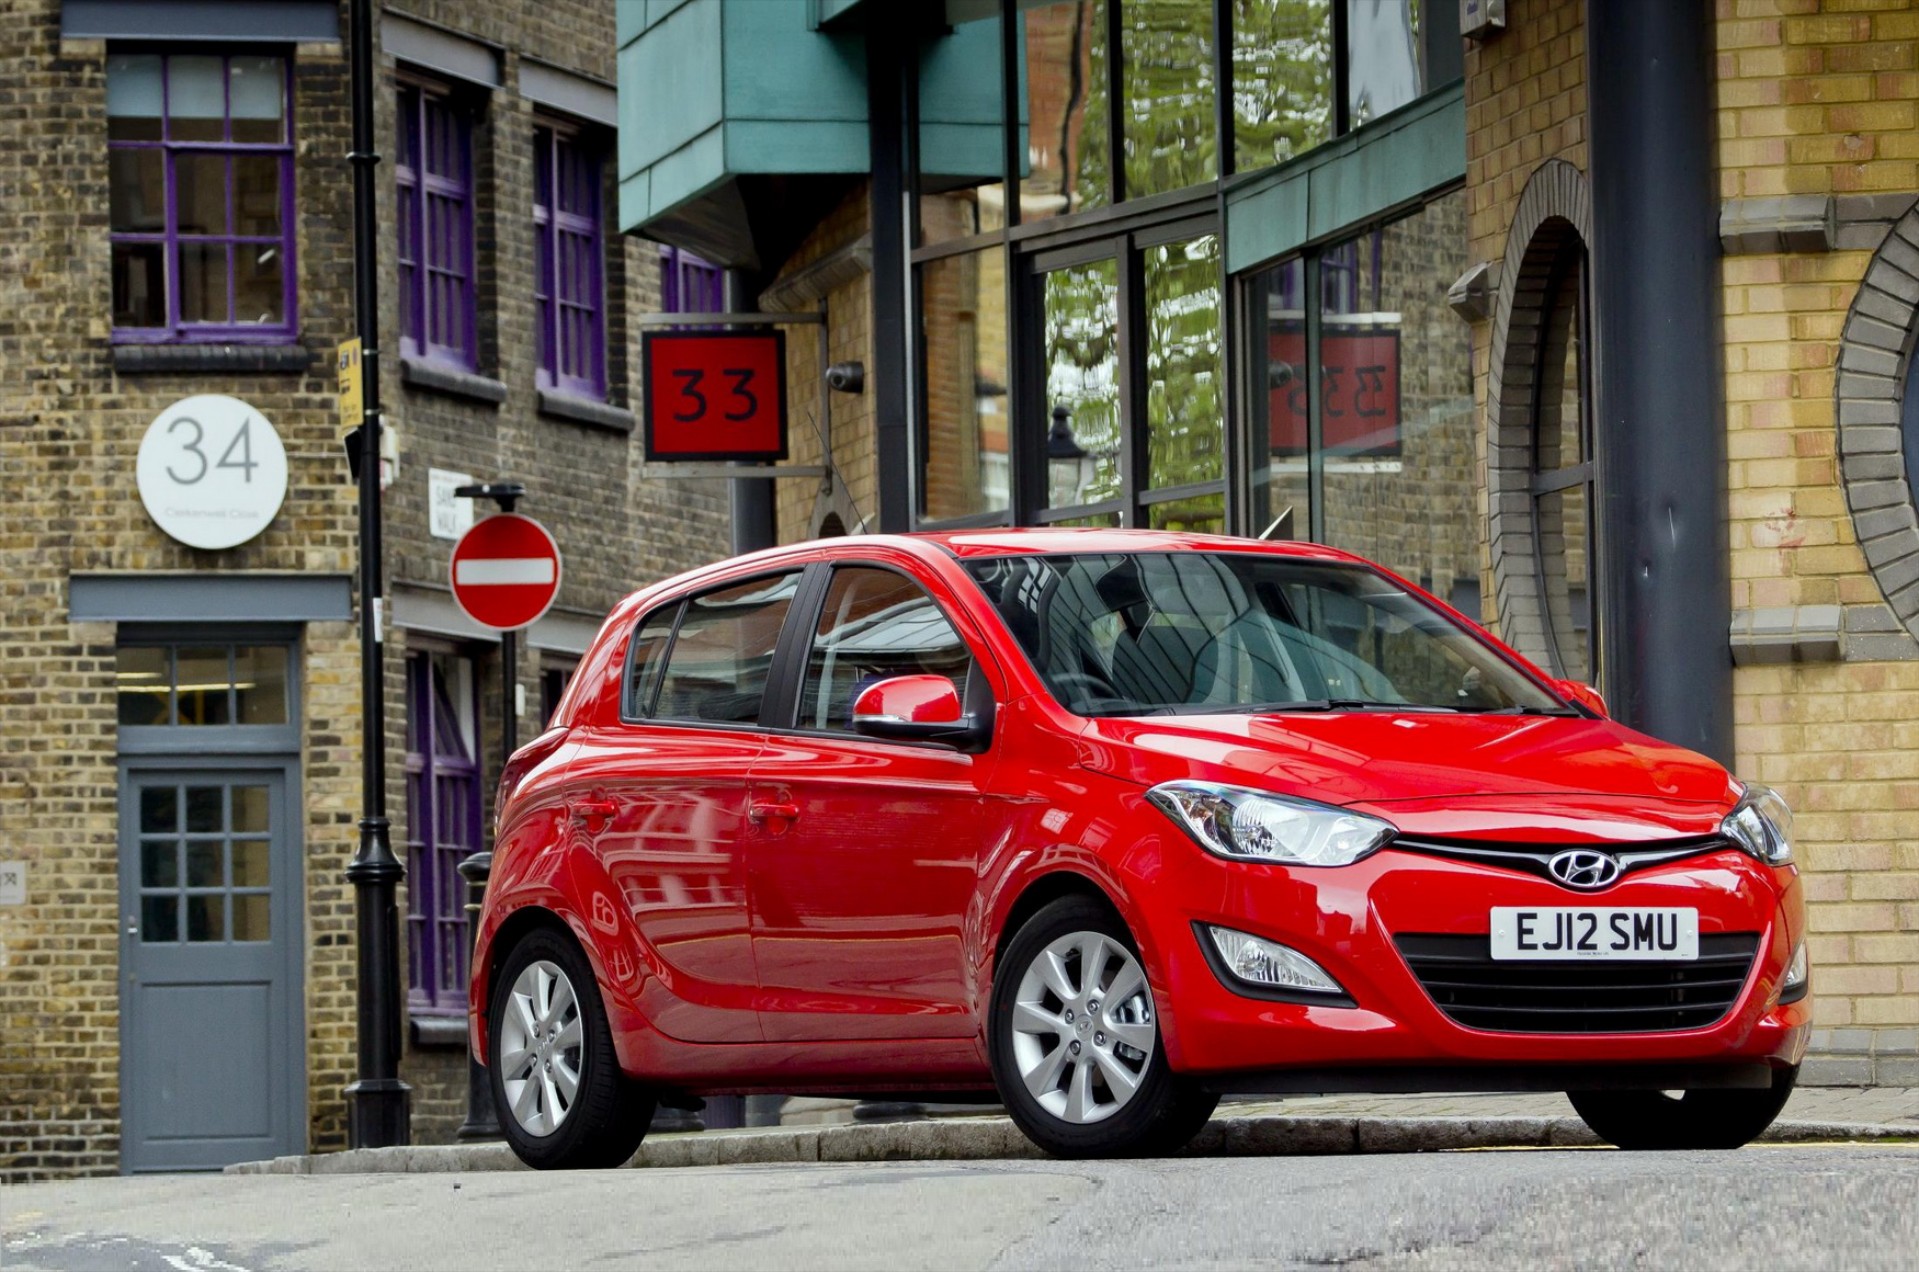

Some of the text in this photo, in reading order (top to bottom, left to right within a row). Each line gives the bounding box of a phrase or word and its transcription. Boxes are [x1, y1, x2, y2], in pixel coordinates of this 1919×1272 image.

[673, 368, 757, 422] 33
[166, 416, 259, 485] 34
[1517, 913, 1677, 950] EJ12 SMU
